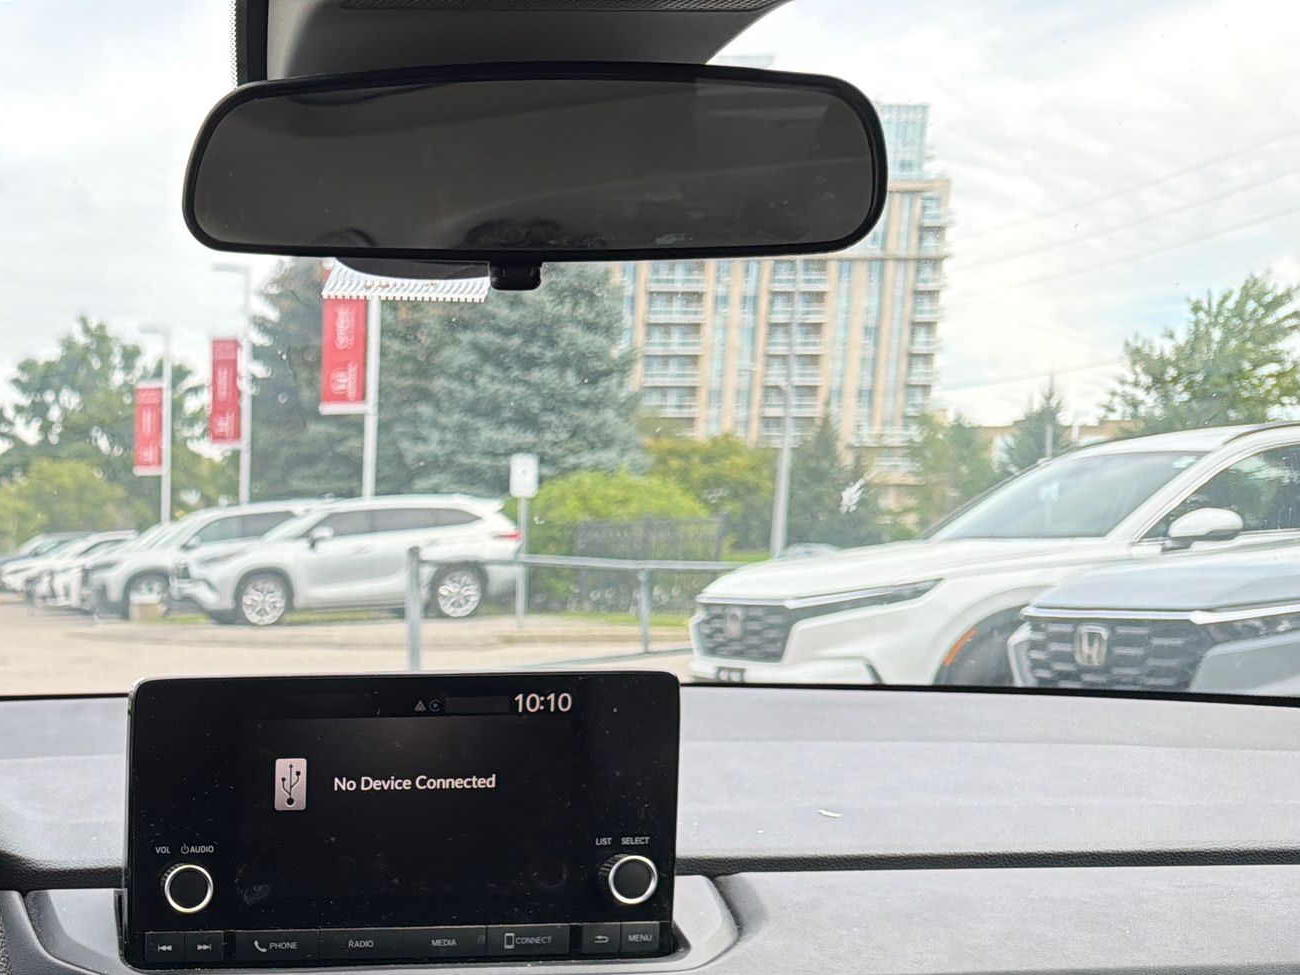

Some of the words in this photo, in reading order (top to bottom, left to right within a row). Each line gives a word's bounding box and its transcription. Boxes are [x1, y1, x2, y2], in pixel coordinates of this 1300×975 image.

[514, 693, 572, 712] 10:10
[334, 776, 356, 791] No
[360, 775, 411, 791] Device
[416, 773, 496, 789] Connected
[595, 837, 612, 846] LIST
[621, 836, 650, 845] SELECT
[155, 846, 171, 854] VOL
[190, 845, 214, 853] AUDIO
[515, 936, 552, 945] CONNECT
[628, 934, 652, 942] MENU
[269, 942, 299, 950] PHONE
[348, 940, 374, 948] RADIO
[431, 939, 457, 947] MEDIA
